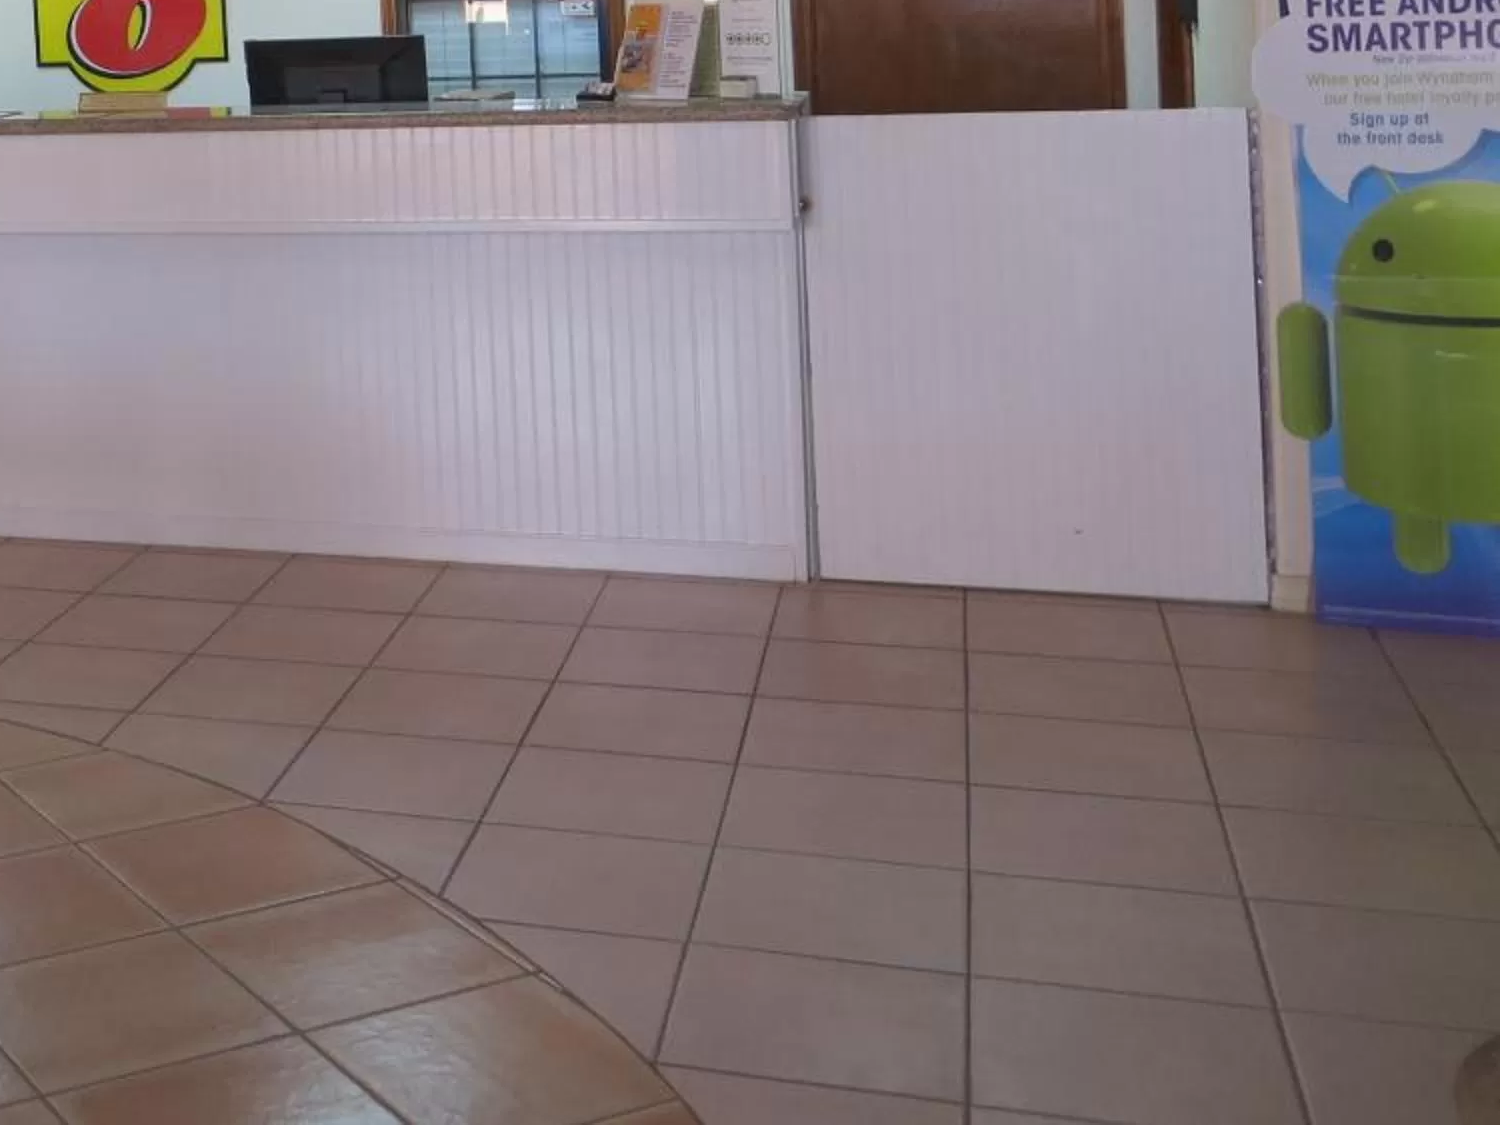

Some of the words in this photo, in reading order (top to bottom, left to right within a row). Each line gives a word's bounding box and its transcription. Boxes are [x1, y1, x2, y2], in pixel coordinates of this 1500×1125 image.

[1353, 74, 1379, 87] you
[1350, 112, 1384, 128] Sign
[1389, 114, 1409, 128] up
[1414, 113, 1429, 125] at
[1337, 130, 1361, 145] the
[1366, 130, 1402, 145] front
[1406, 130, 1444, 145] desk
